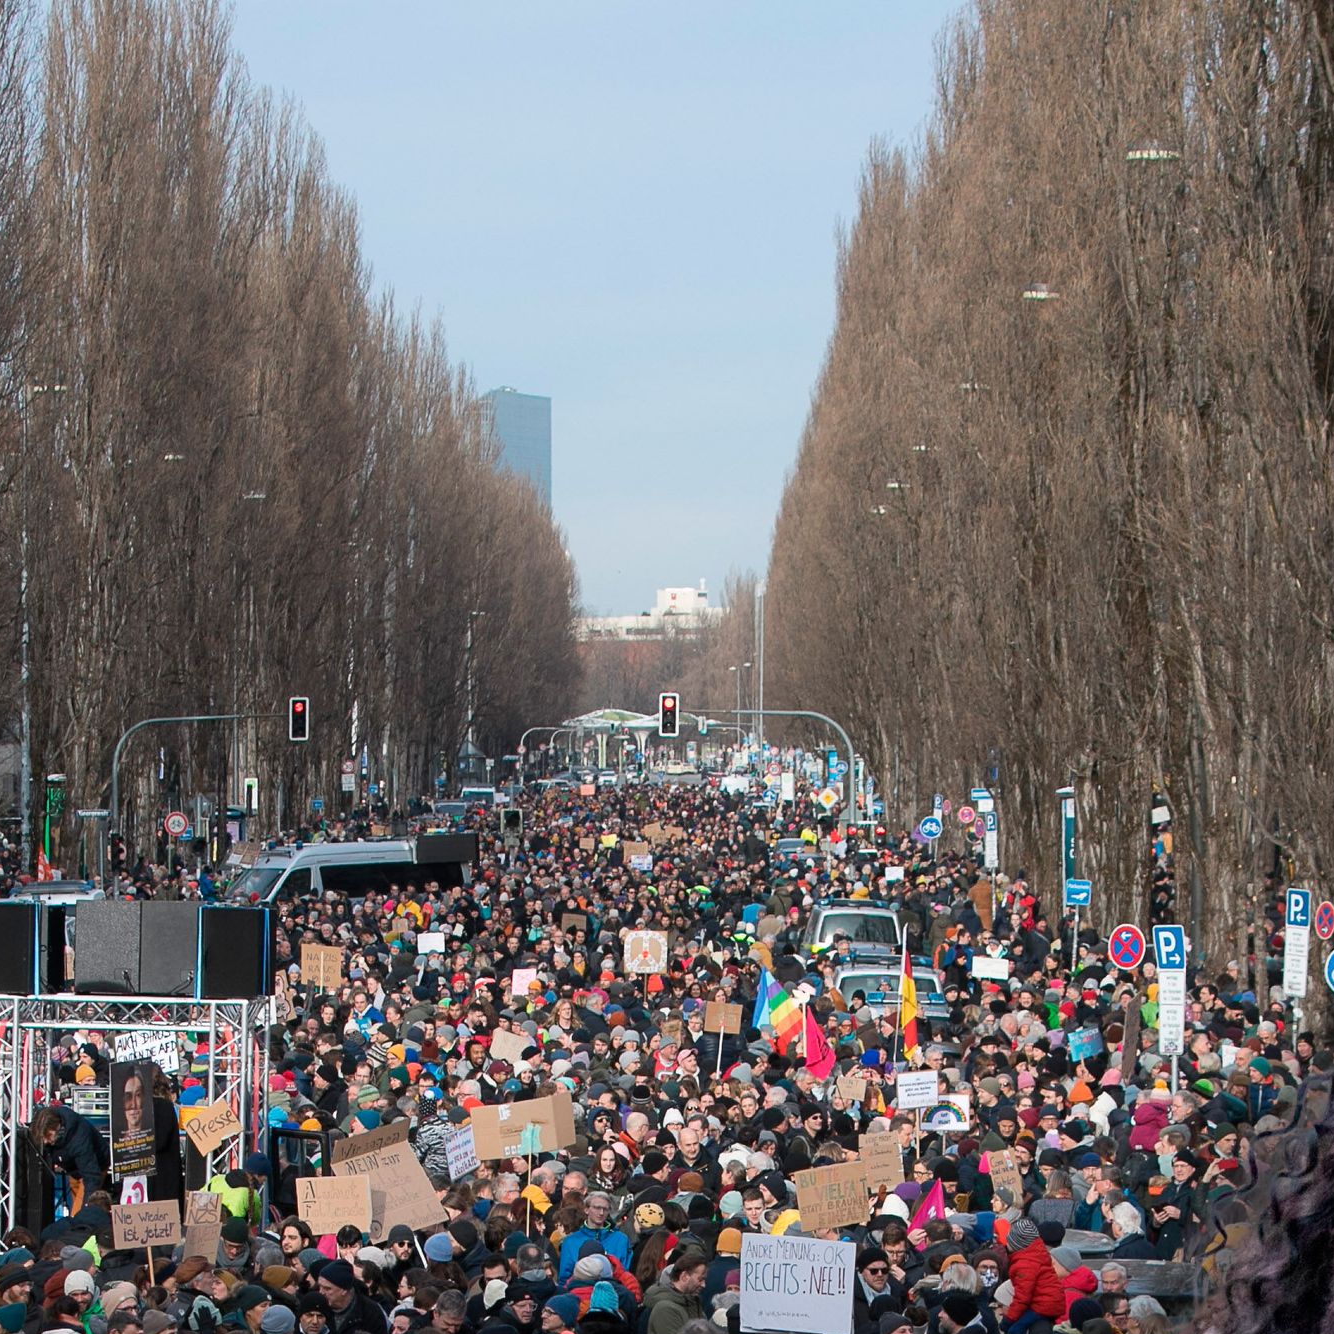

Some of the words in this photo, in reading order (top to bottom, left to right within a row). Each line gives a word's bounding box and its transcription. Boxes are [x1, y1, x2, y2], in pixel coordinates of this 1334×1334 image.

[1290, 893, 1304, 921] P
[1158, 931, 1176, 964] P
[186, 1110, 237, 1141] Presse
[138, 1211, 169, 1223] wieder
[823, 1245, 846, 1266] OK
